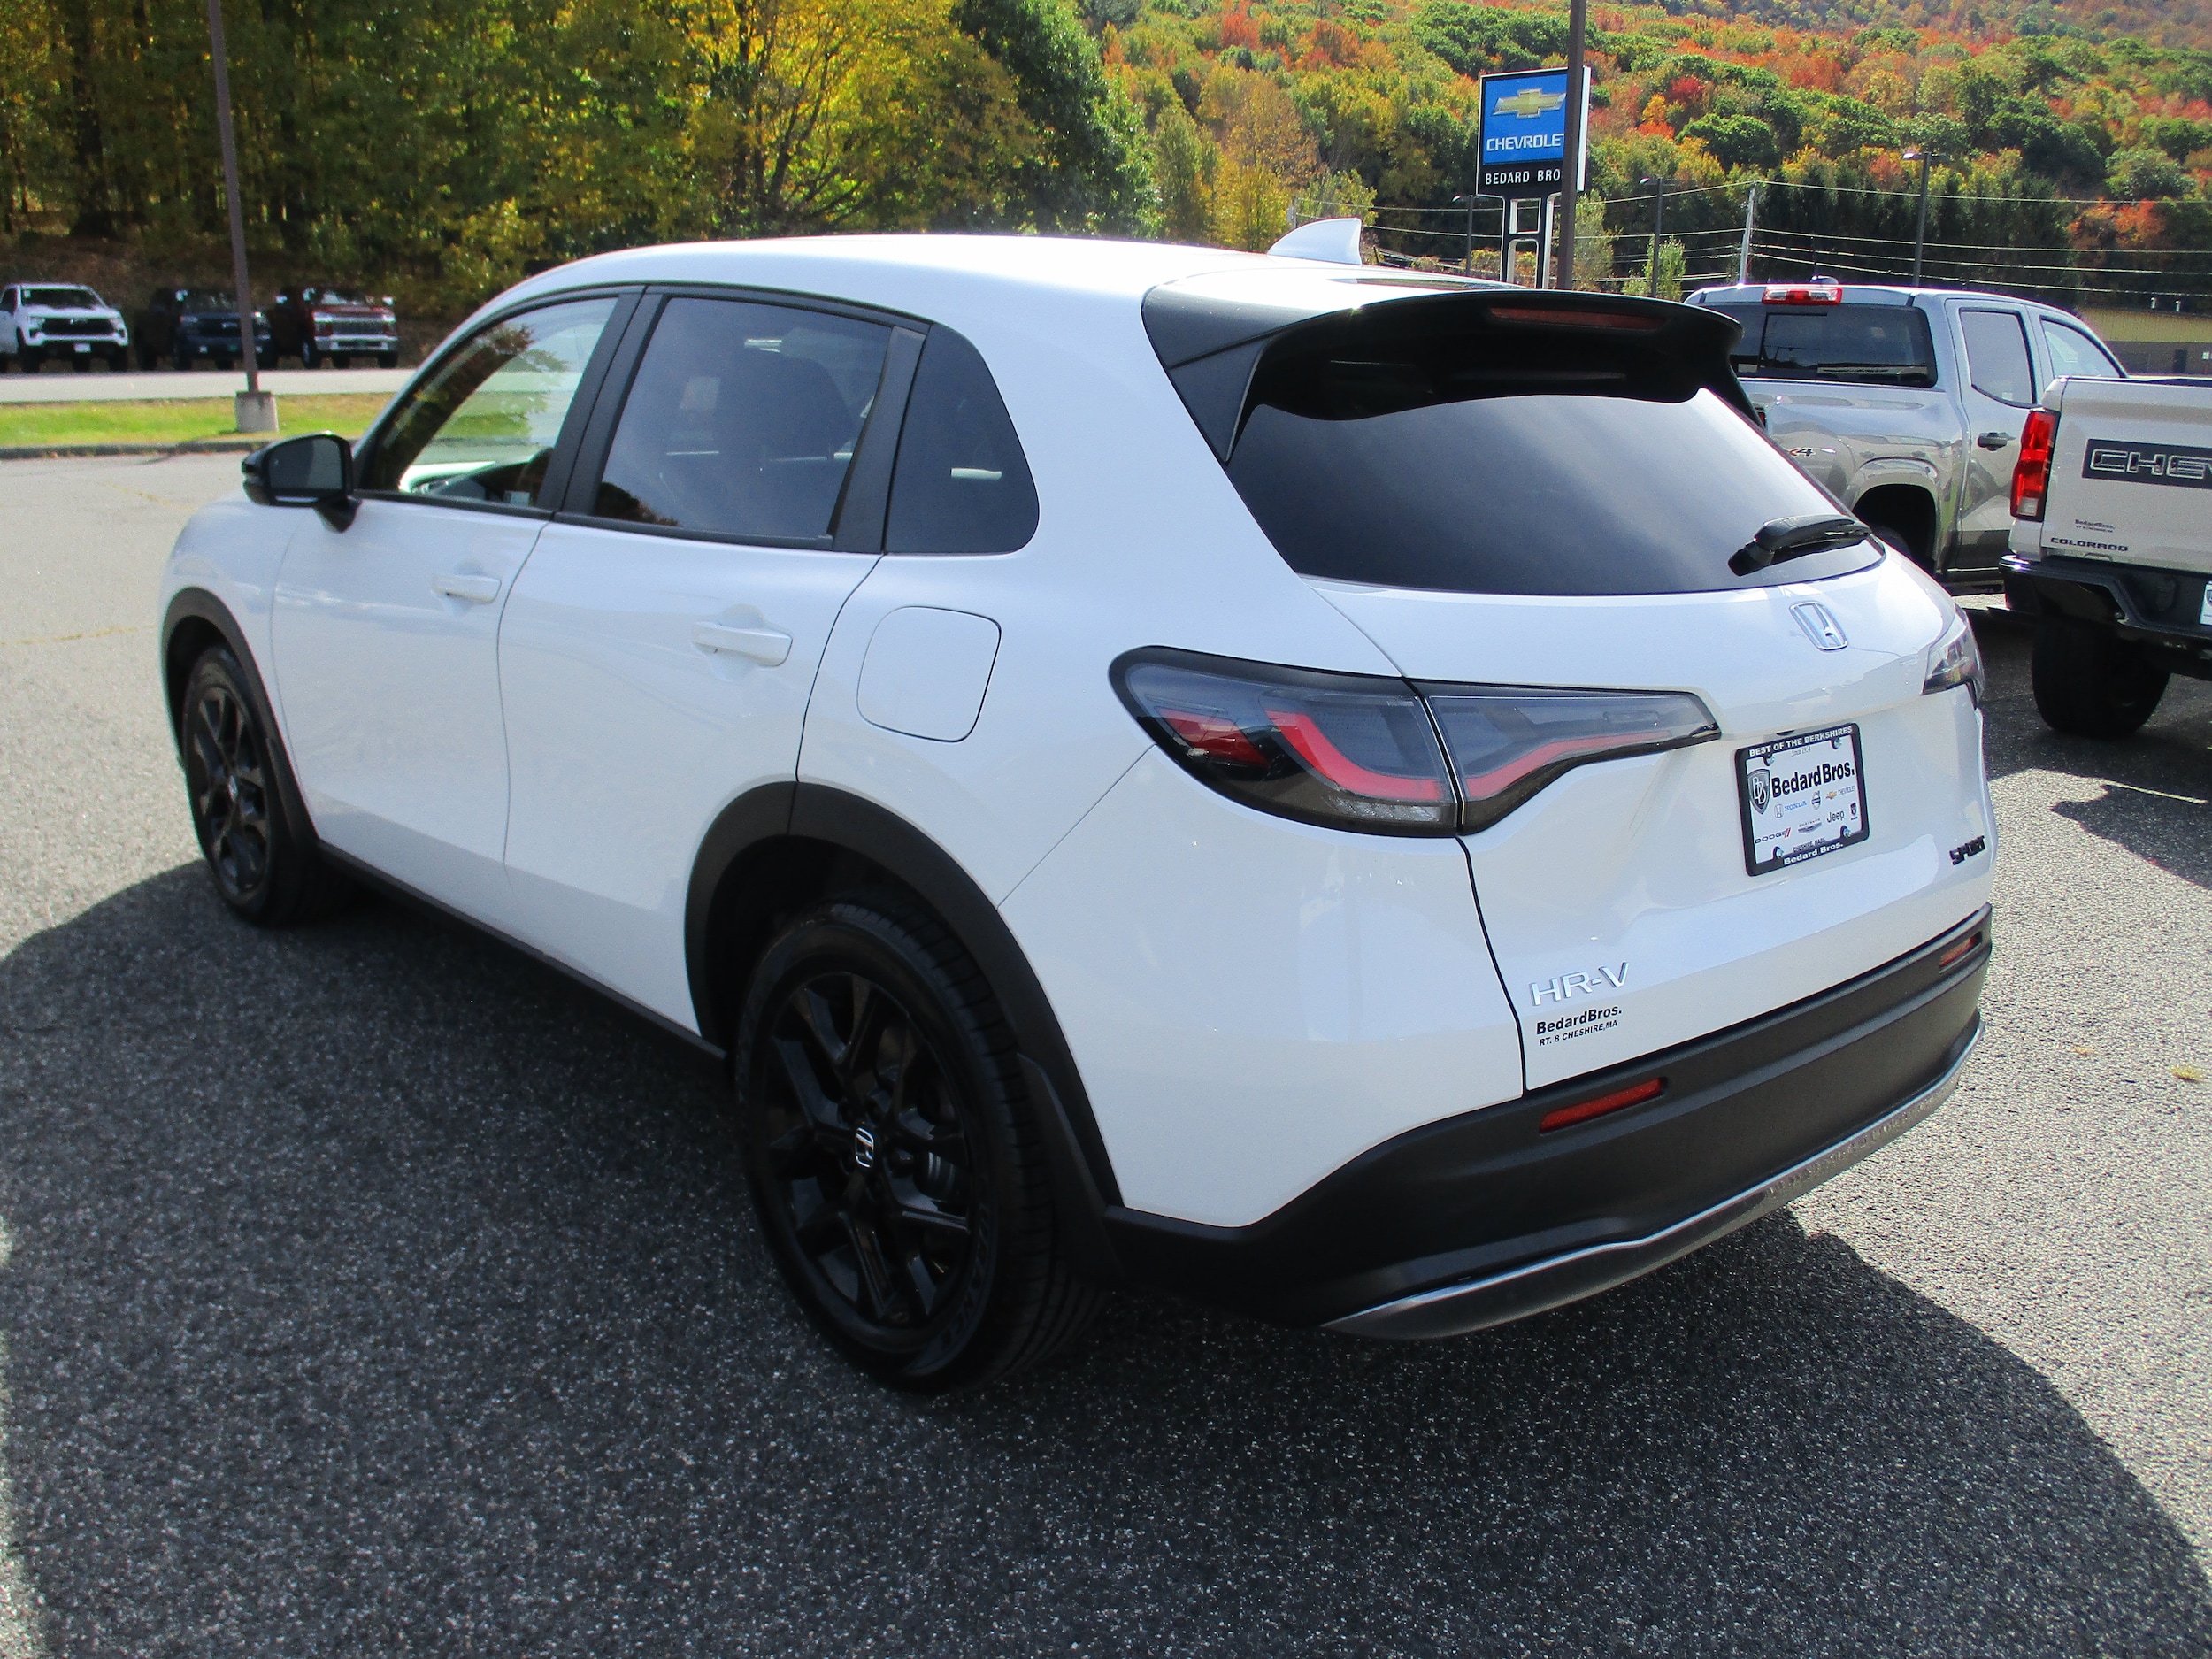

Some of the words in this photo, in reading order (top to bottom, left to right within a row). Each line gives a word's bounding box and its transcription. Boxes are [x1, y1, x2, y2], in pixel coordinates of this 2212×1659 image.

[1485, 171, 1530, 185] BEDARD
[2090, 449, 2212, 479] CHE
[2050, 537, 2129, 552] COLORADO
[1749, 745, 1771, 757] BEST
[1786, 738, 1802, 748] THE
[1804, 726, 1853, 743] BERKSHIRES
[1785, 801, 1807, 811] HONDA
[1827, 810, 1845, 823] Jeep
[1755, 830, 1787, 844] DODGE
[1784, 848, 1817, 865] Bedard
[1820, 842, 1843, 855] Bros.
[1949, 835, 1985, 865] SPORT
[1530, 961, 1629, 1006] HR-V
[1540, 1037, 1552, 1047] RT.
